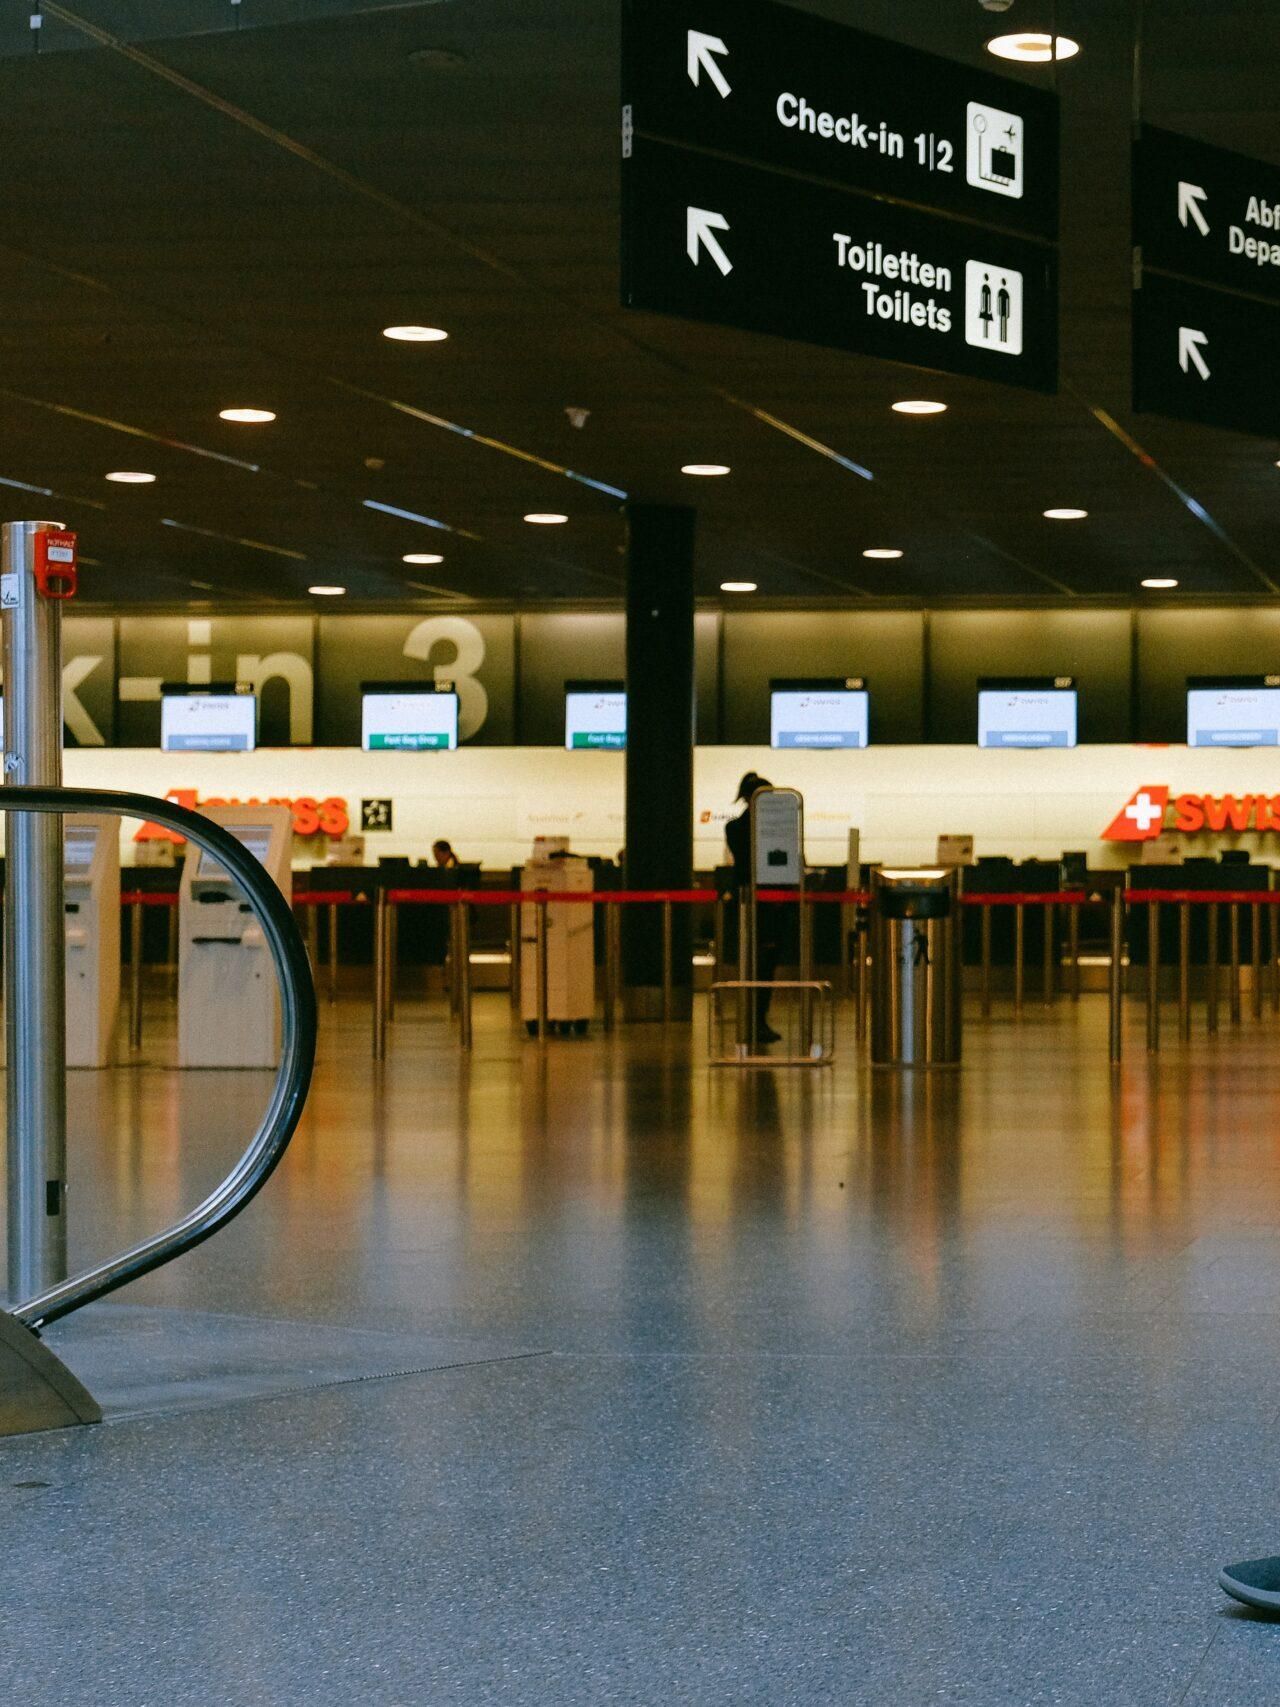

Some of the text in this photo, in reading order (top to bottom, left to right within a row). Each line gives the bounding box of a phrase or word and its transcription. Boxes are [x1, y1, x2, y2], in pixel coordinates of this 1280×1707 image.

[776, 92, 904, 158] Check-in
[833, 233, 952, 292] Toiletten
[862, 282, 952, 333] Toilets
[402, 616, 489, 742] 3
